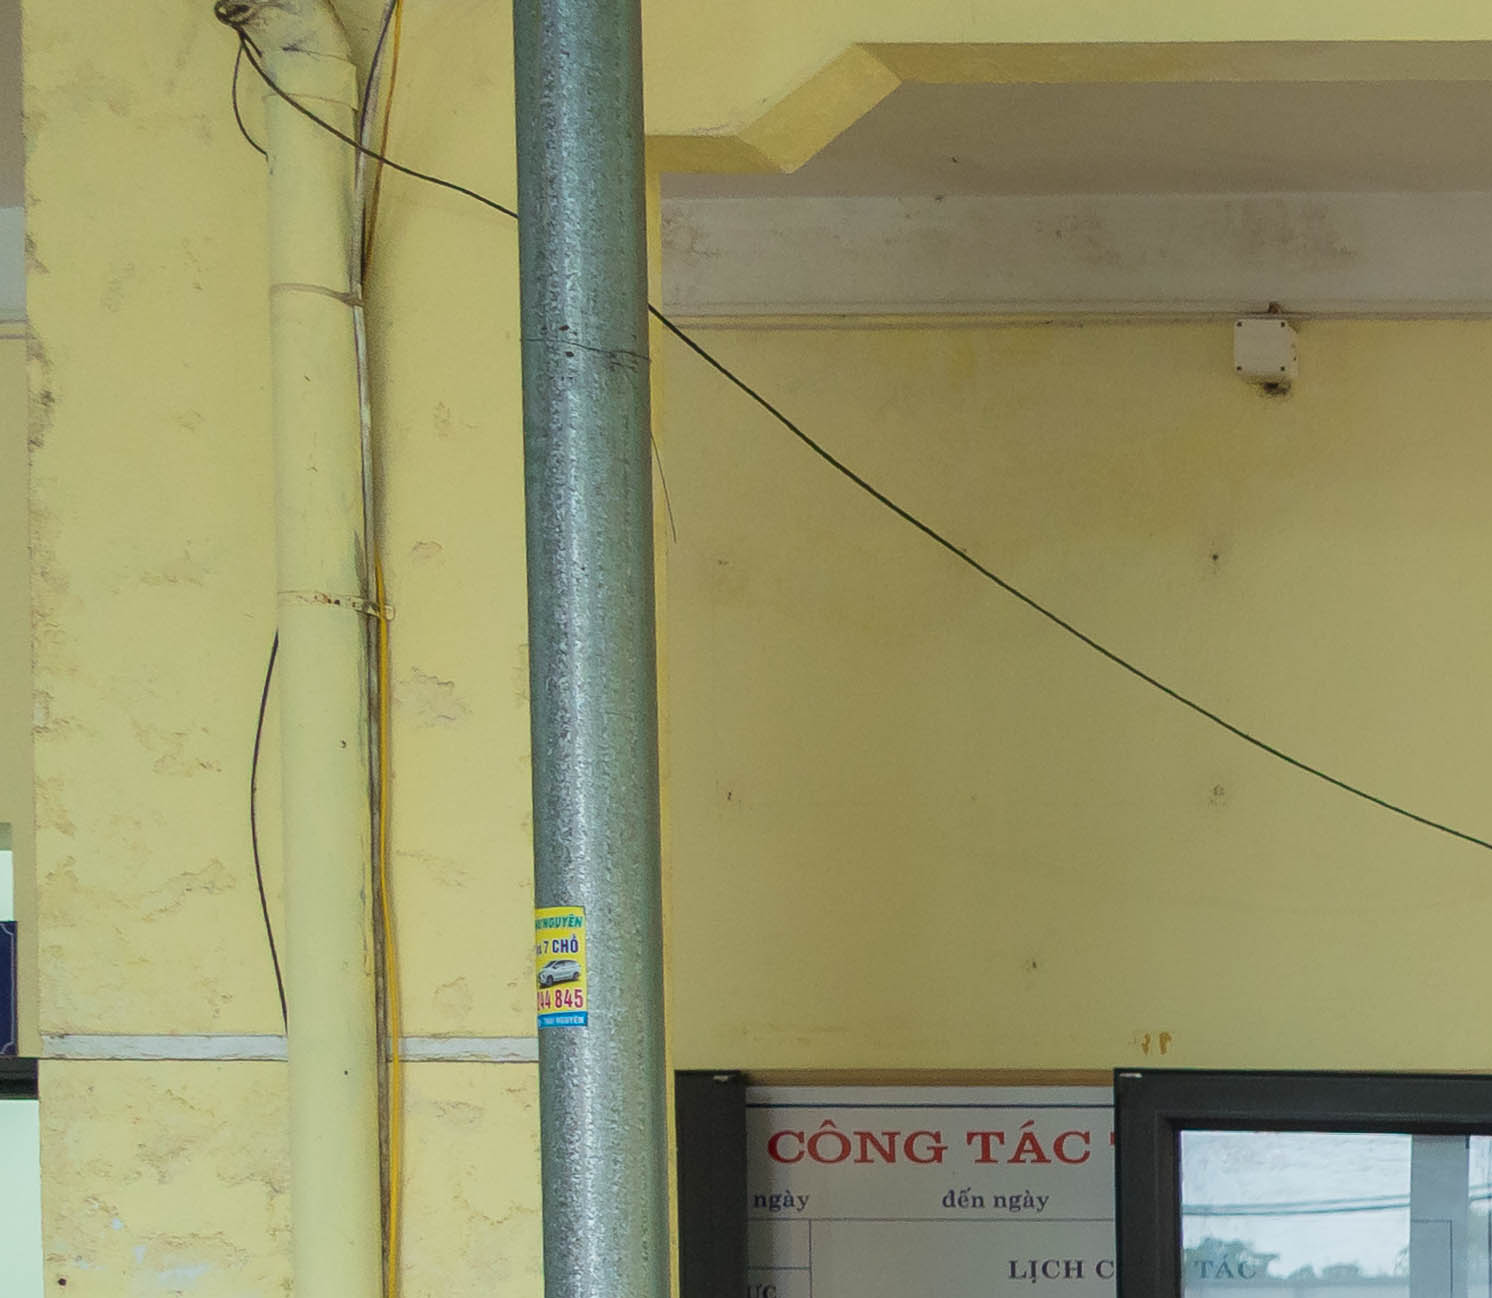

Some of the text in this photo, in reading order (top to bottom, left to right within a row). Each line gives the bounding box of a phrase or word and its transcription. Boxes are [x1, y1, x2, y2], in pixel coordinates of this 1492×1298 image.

[555, 989, 583, 1008] 845
[768, 1119, 1091, 1164] CÔNG TÁC
[753, 1188, 1050, 1213] ngày đến ngày
[1008, 1260, 1084, 1283] LỊCH
